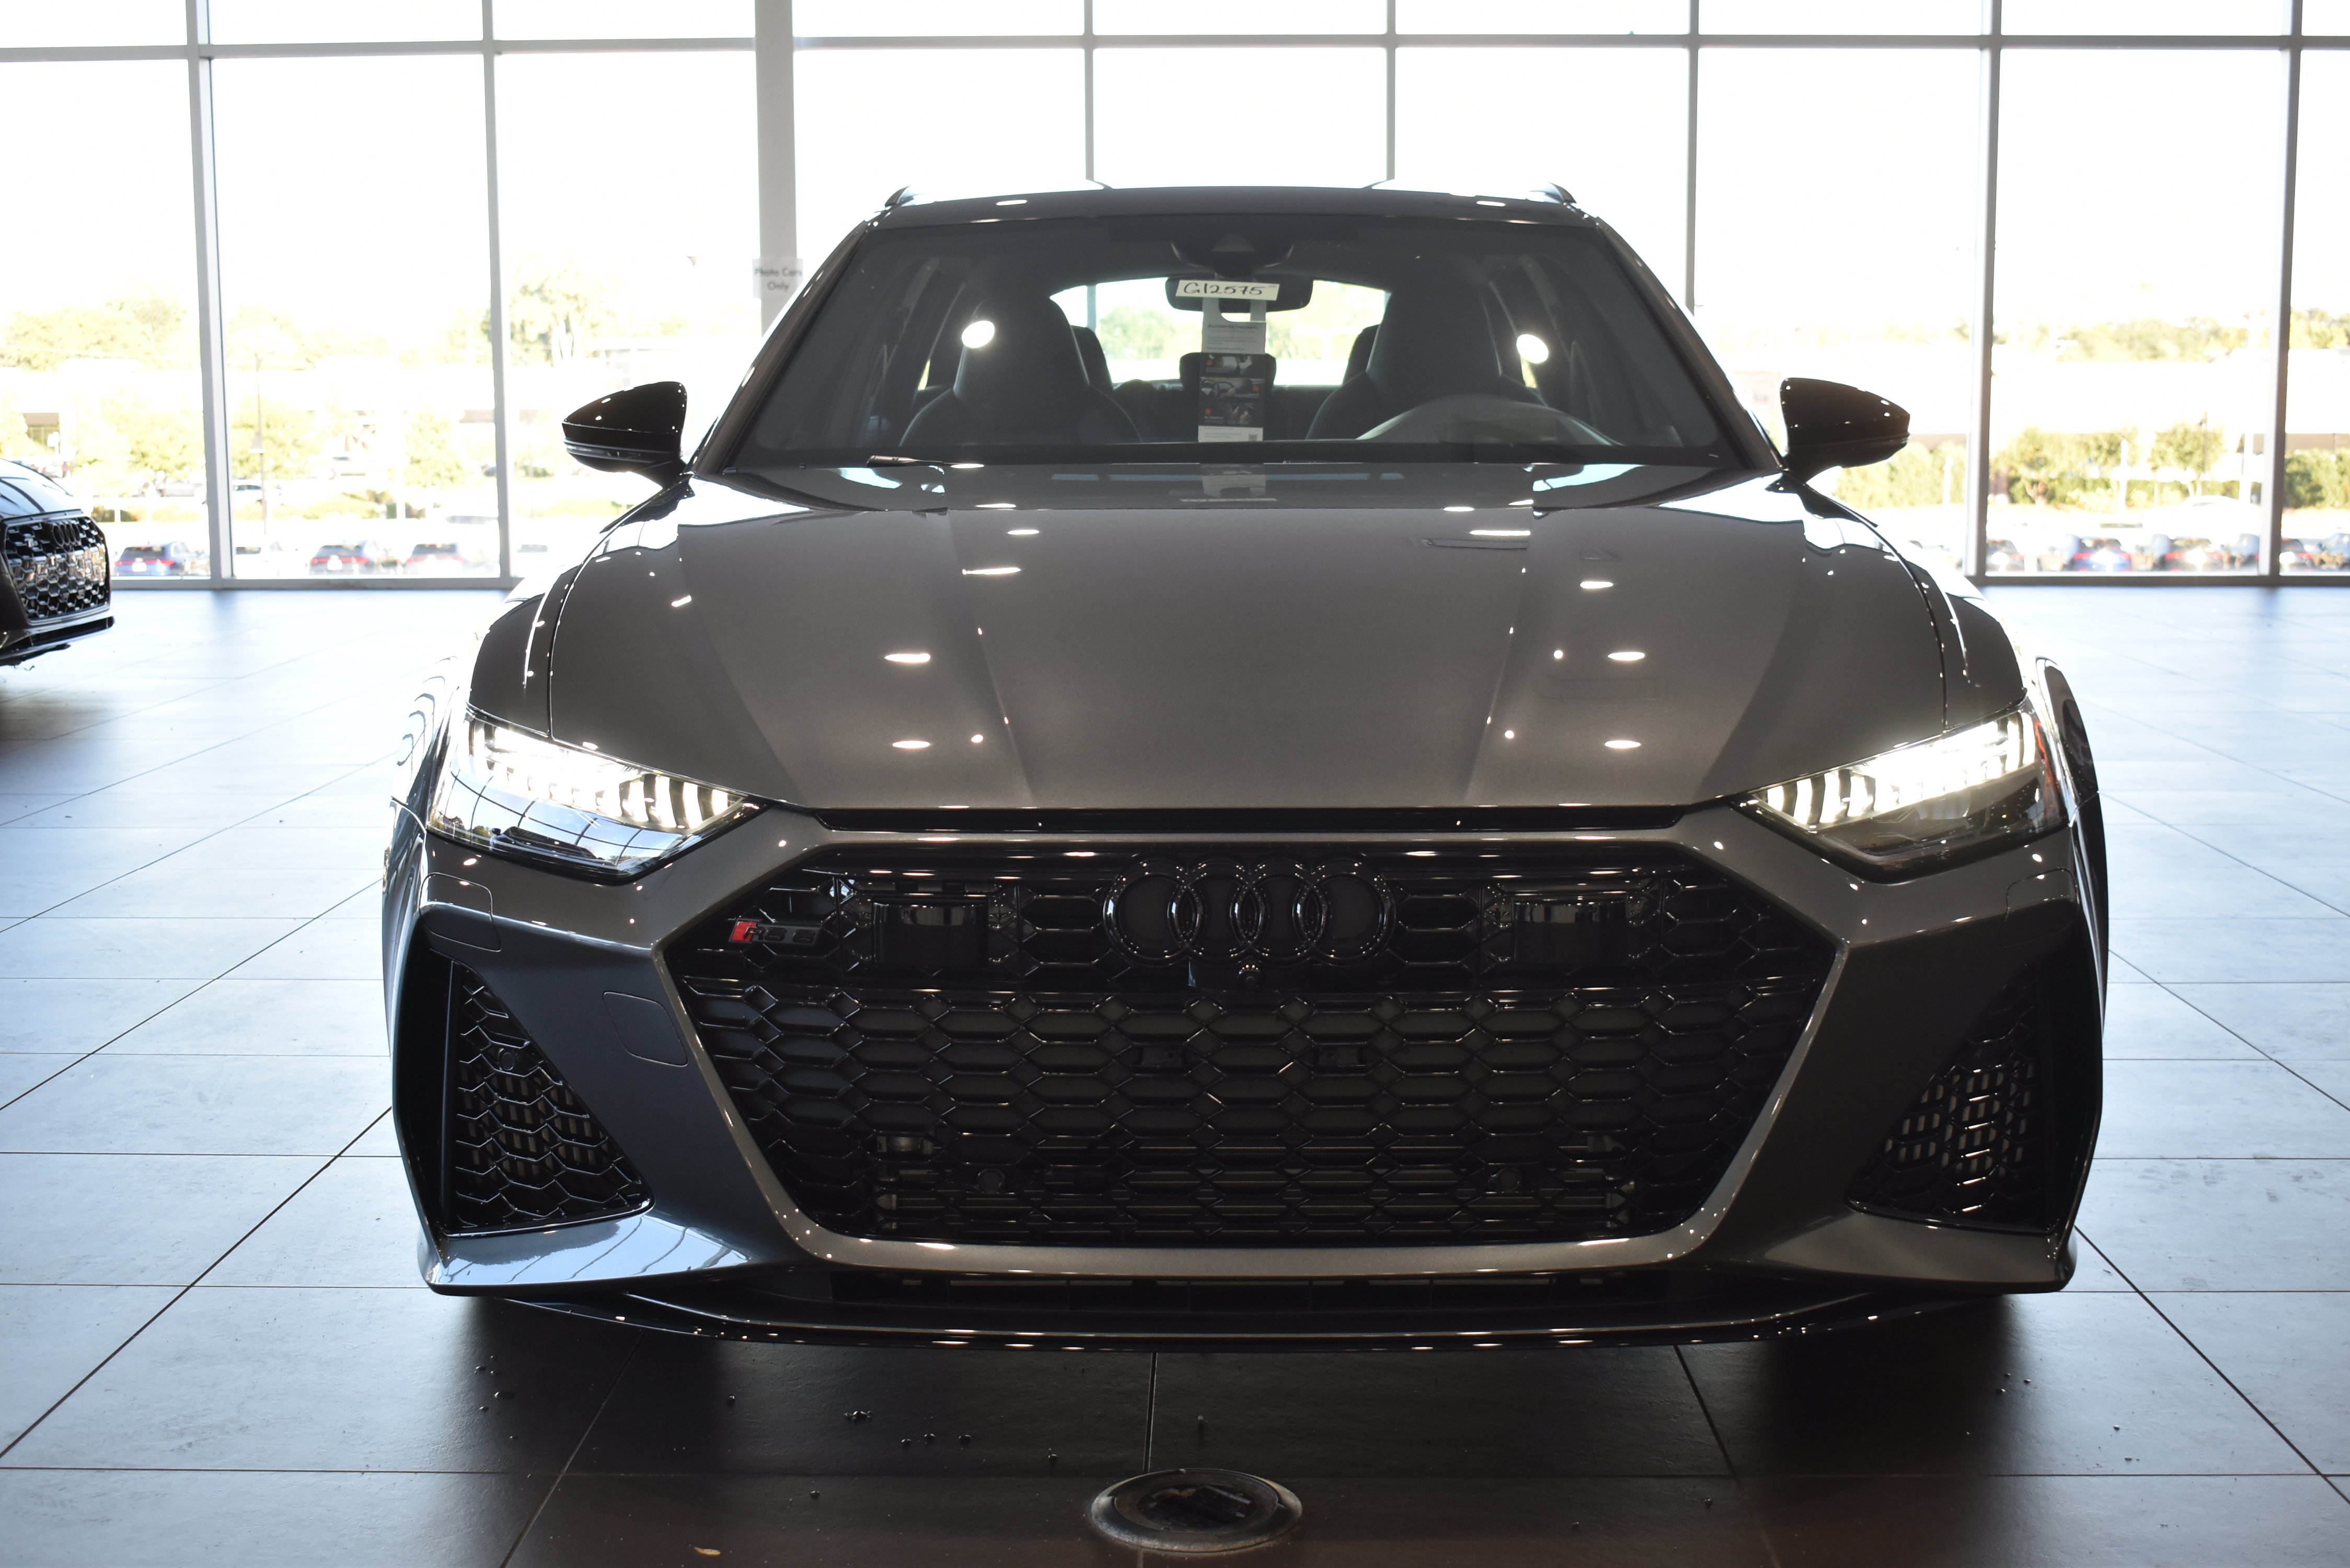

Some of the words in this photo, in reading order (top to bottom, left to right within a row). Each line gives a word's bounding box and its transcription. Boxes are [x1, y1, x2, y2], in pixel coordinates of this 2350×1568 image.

[754, 267, 779, 277] Photo
[767, 281, 789, 292] Only
[743, 926, 787, 942] RS
